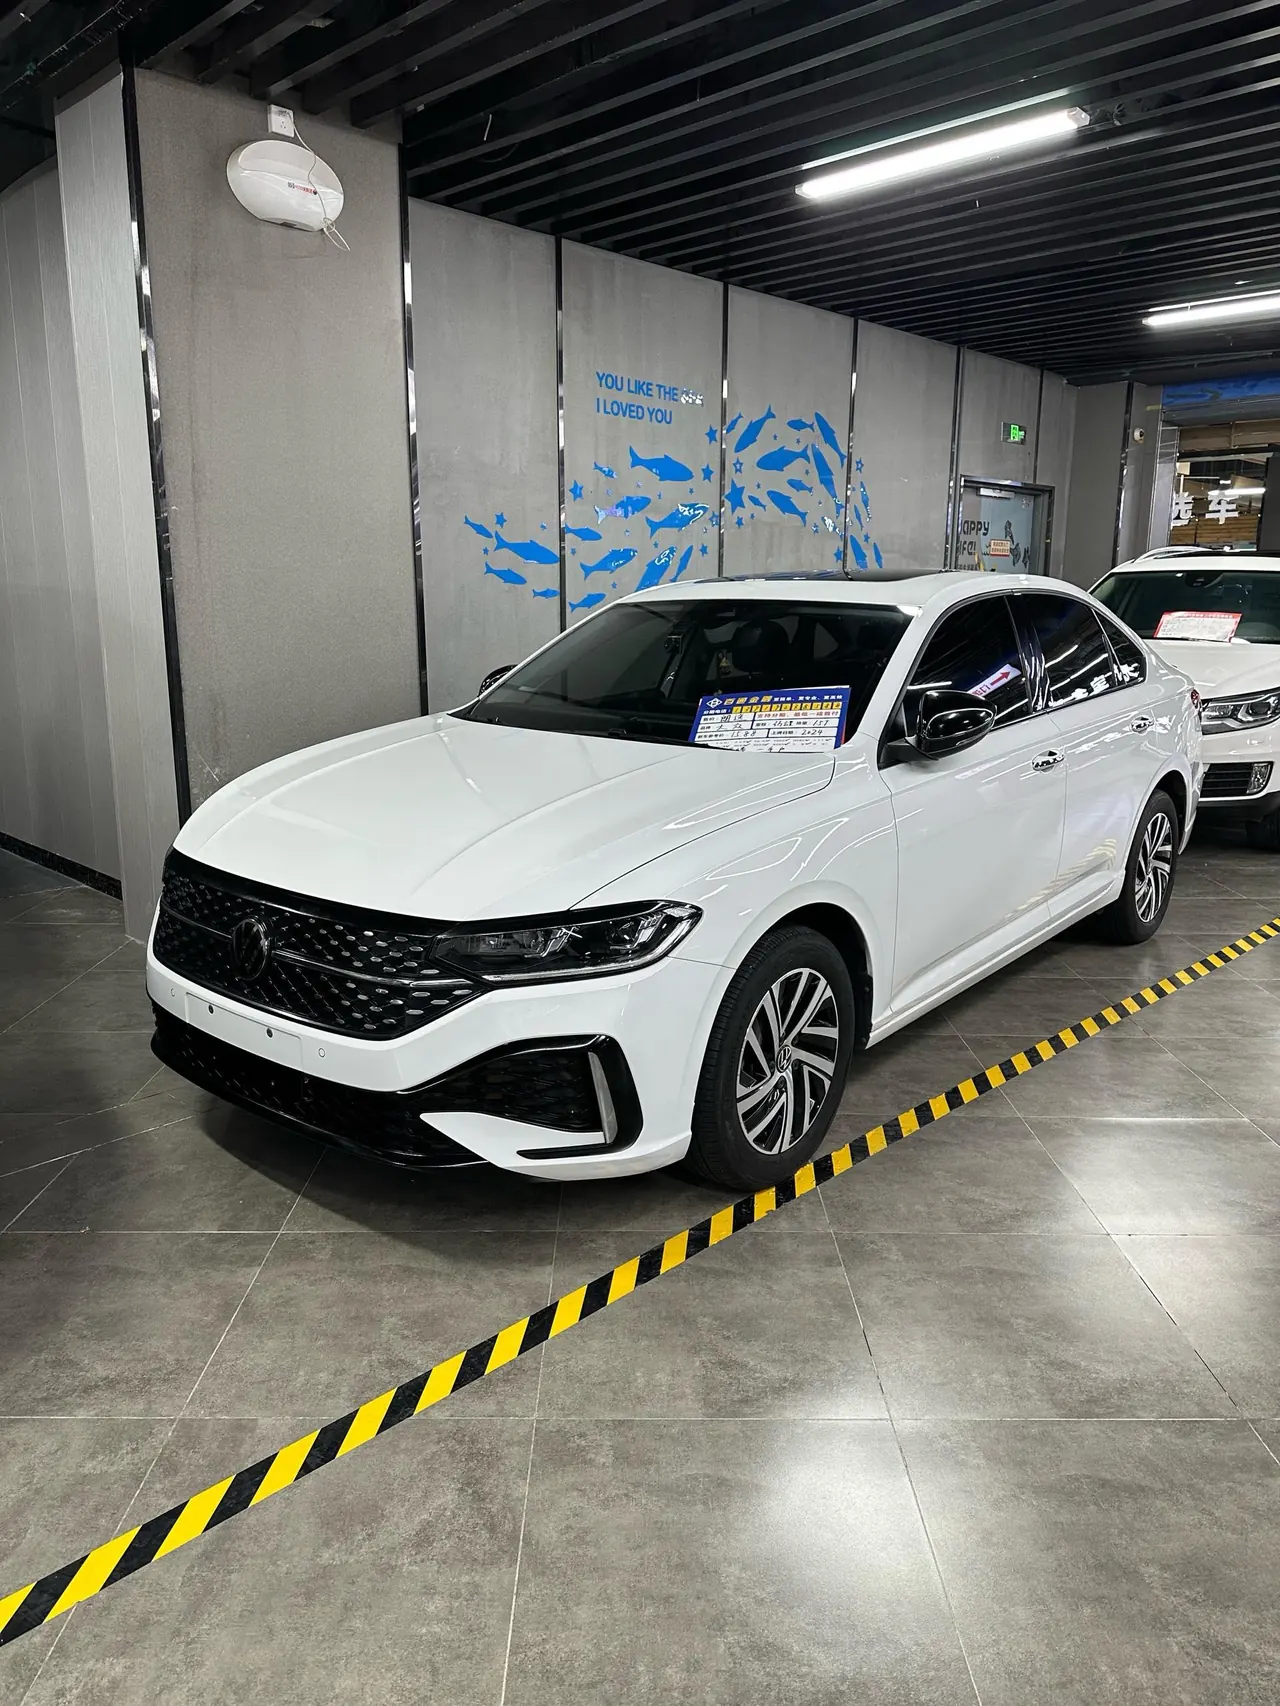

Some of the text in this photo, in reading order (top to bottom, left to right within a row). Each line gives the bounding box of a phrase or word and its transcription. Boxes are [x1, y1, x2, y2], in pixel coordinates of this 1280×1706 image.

[596, 371, 624, 391] YOU
[627, 378, 653, 397] LIKE
[656, 384, 679, 402] THE
[596, 397, 672, 424] I LOVED YOU
